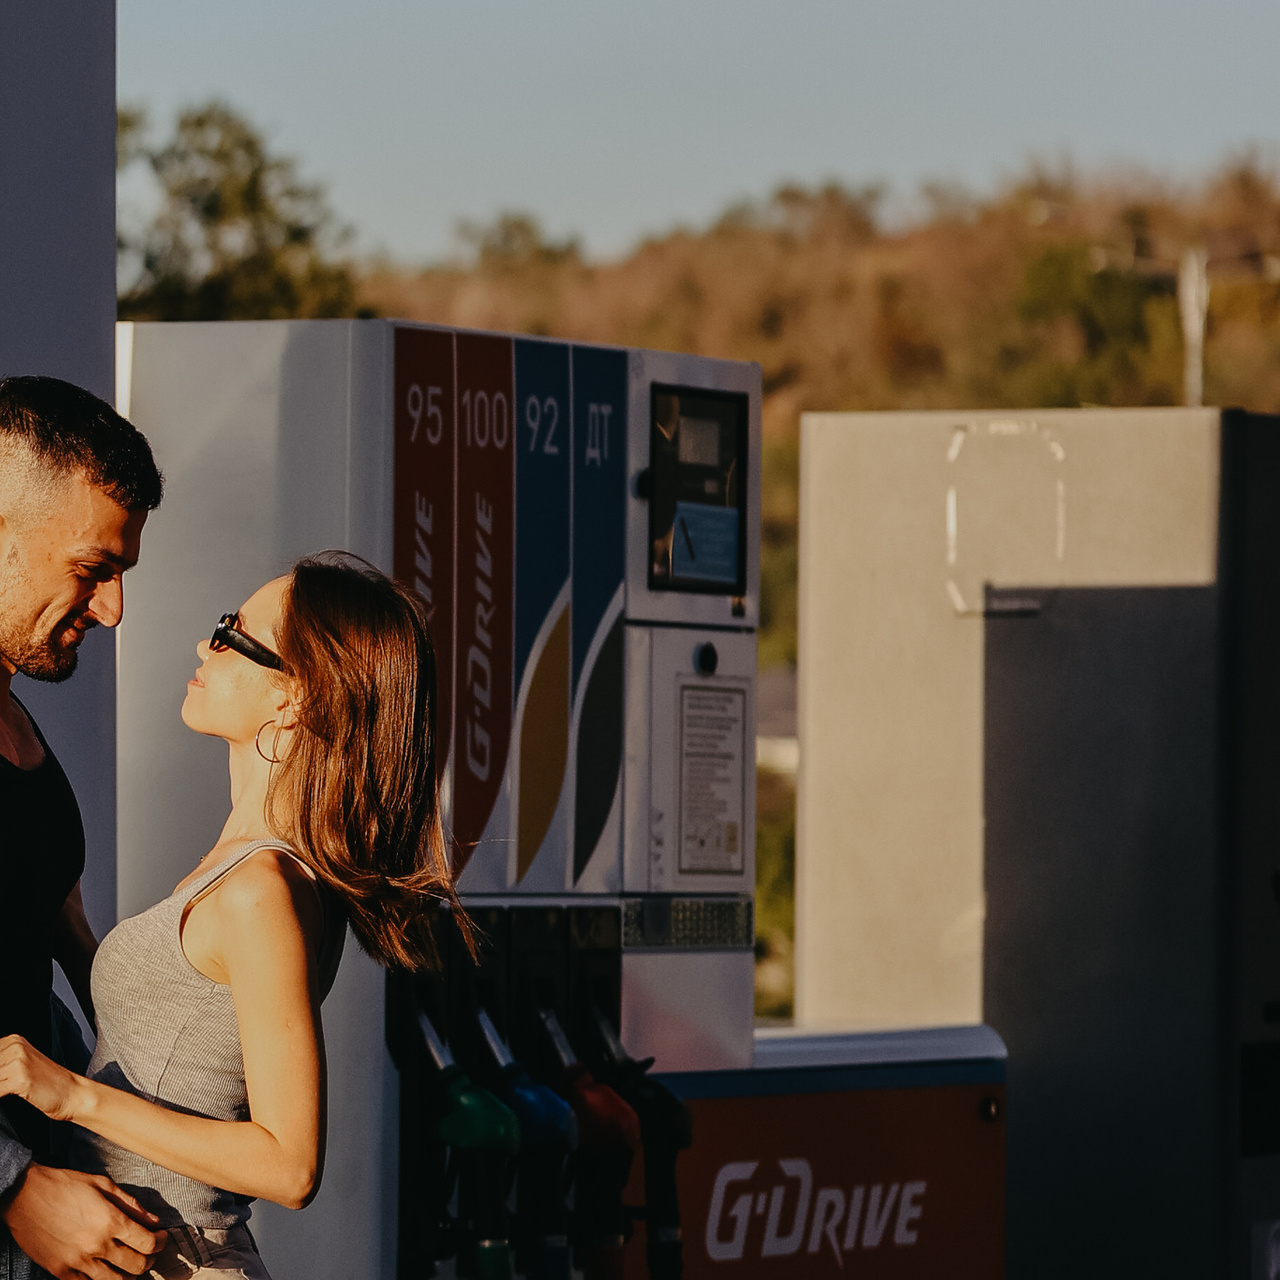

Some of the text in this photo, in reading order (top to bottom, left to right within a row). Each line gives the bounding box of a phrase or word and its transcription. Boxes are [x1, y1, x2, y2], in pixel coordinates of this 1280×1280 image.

[407, 384, 444, 446] 95
[462, 389, 509, 450] 100
[526, 394, 560, 456] 92
[585, 402, 614, 468] ДТ
[415, 490, 437, 622] IVE
